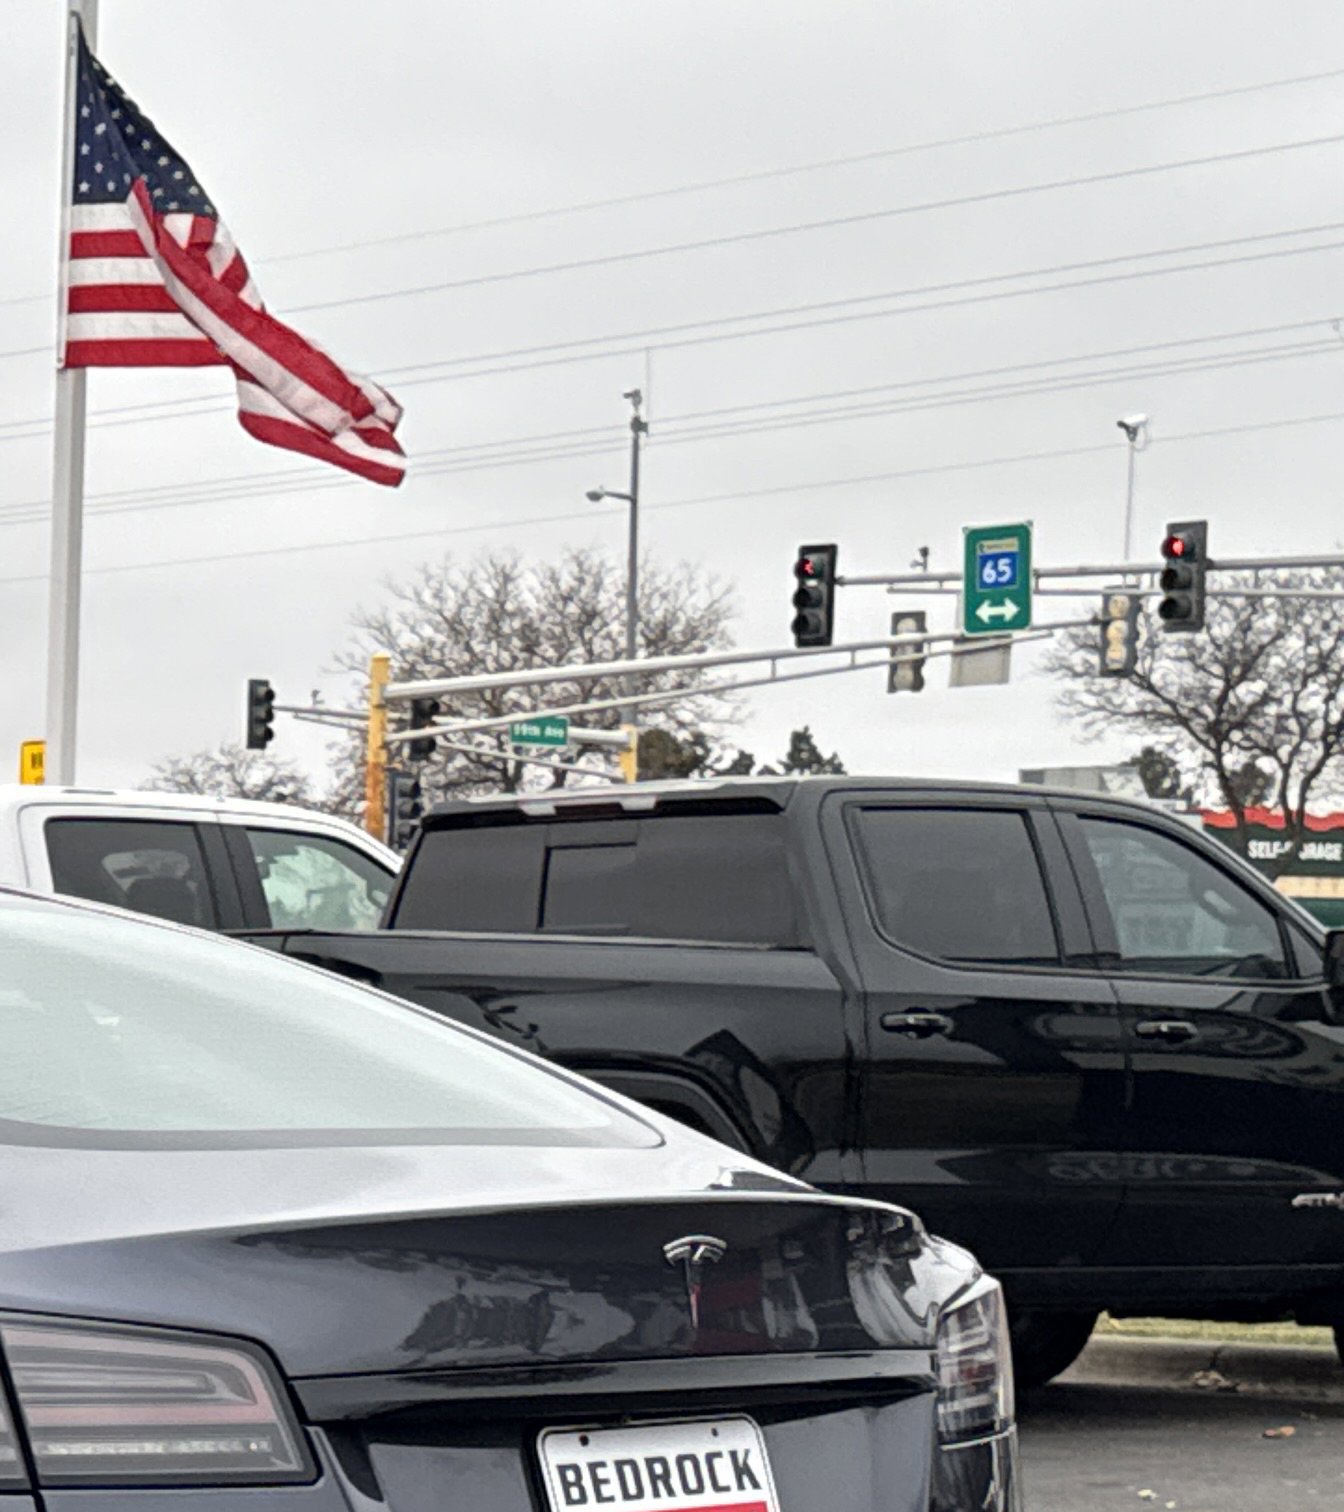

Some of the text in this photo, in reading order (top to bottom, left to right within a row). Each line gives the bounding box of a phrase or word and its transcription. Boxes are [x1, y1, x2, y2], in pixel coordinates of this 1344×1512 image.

[981, 557, 1012, 584] 65
[1247, 839, 1342, 861] SELF-RAGE
[556, 1448, 762, 1506] BEDROCK
